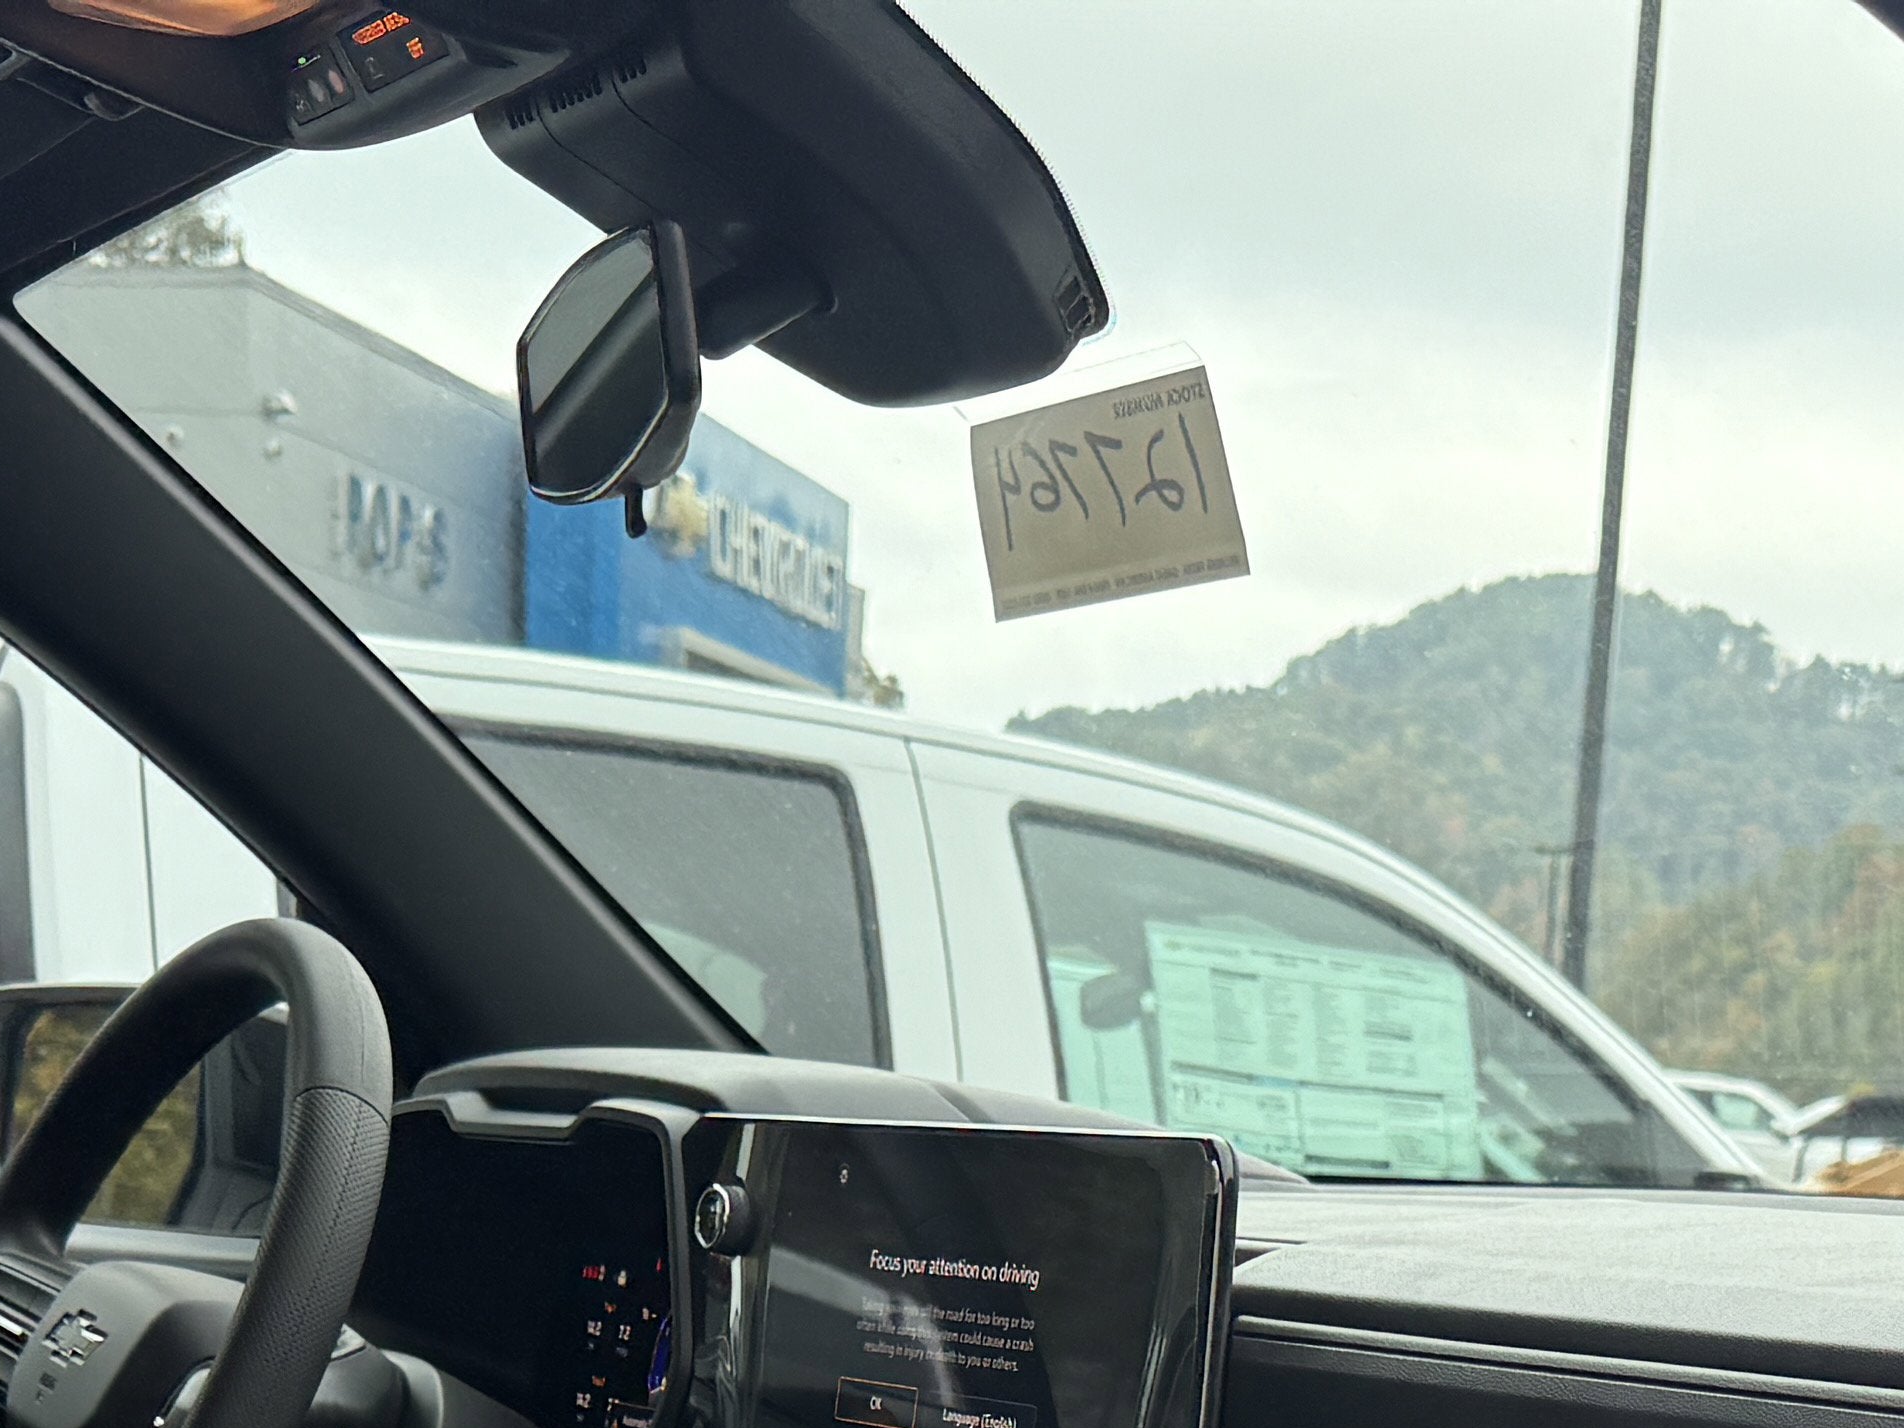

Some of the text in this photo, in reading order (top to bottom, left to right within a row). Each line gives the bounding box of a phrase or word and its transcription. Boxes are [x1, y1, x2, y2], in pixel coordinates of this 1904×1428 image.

[870, 1249, 1040, 1291] Focus your attention on driving
